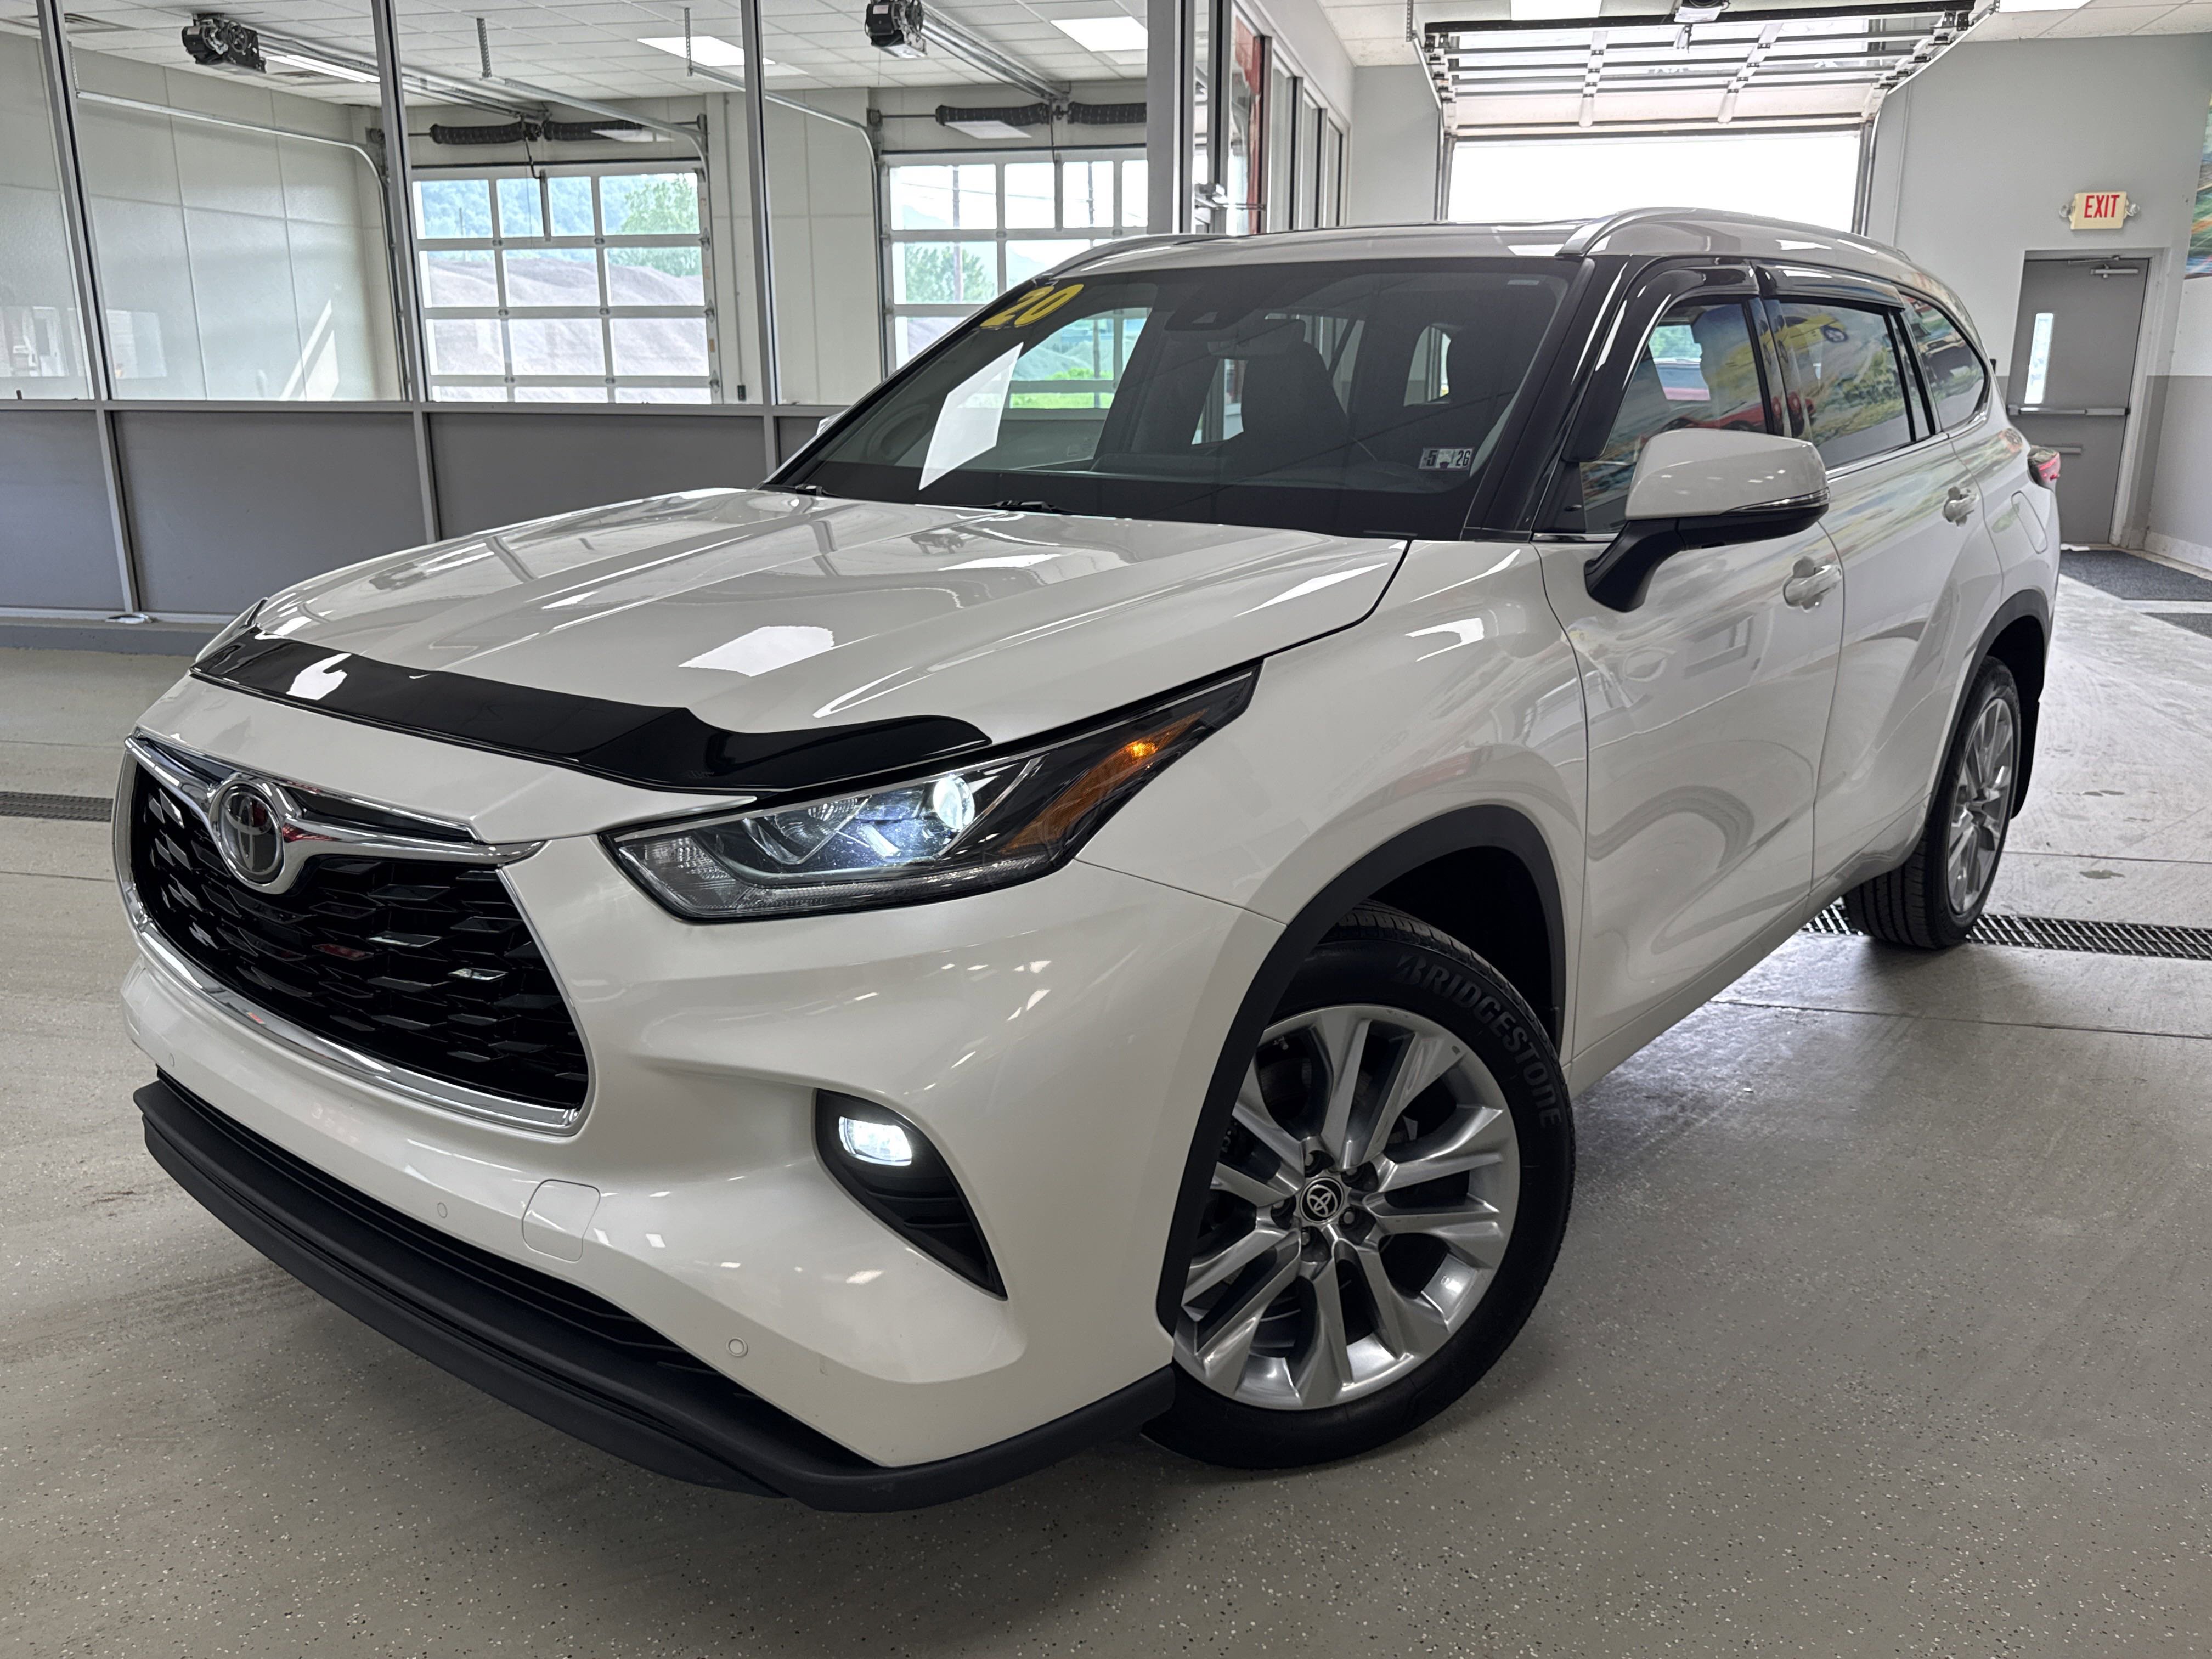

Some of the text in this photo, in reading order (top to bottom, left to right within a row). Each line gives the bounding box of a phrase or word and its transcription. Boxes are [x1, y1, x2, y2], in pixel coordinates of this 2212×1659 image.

[2084, 195, 2119, 218] EXIT
[980, 284, 1084, 328] 20
[1426, 450, 1471, 466] 5 26
[1396, 953, 1562, 1128] BRIDGESTONE
